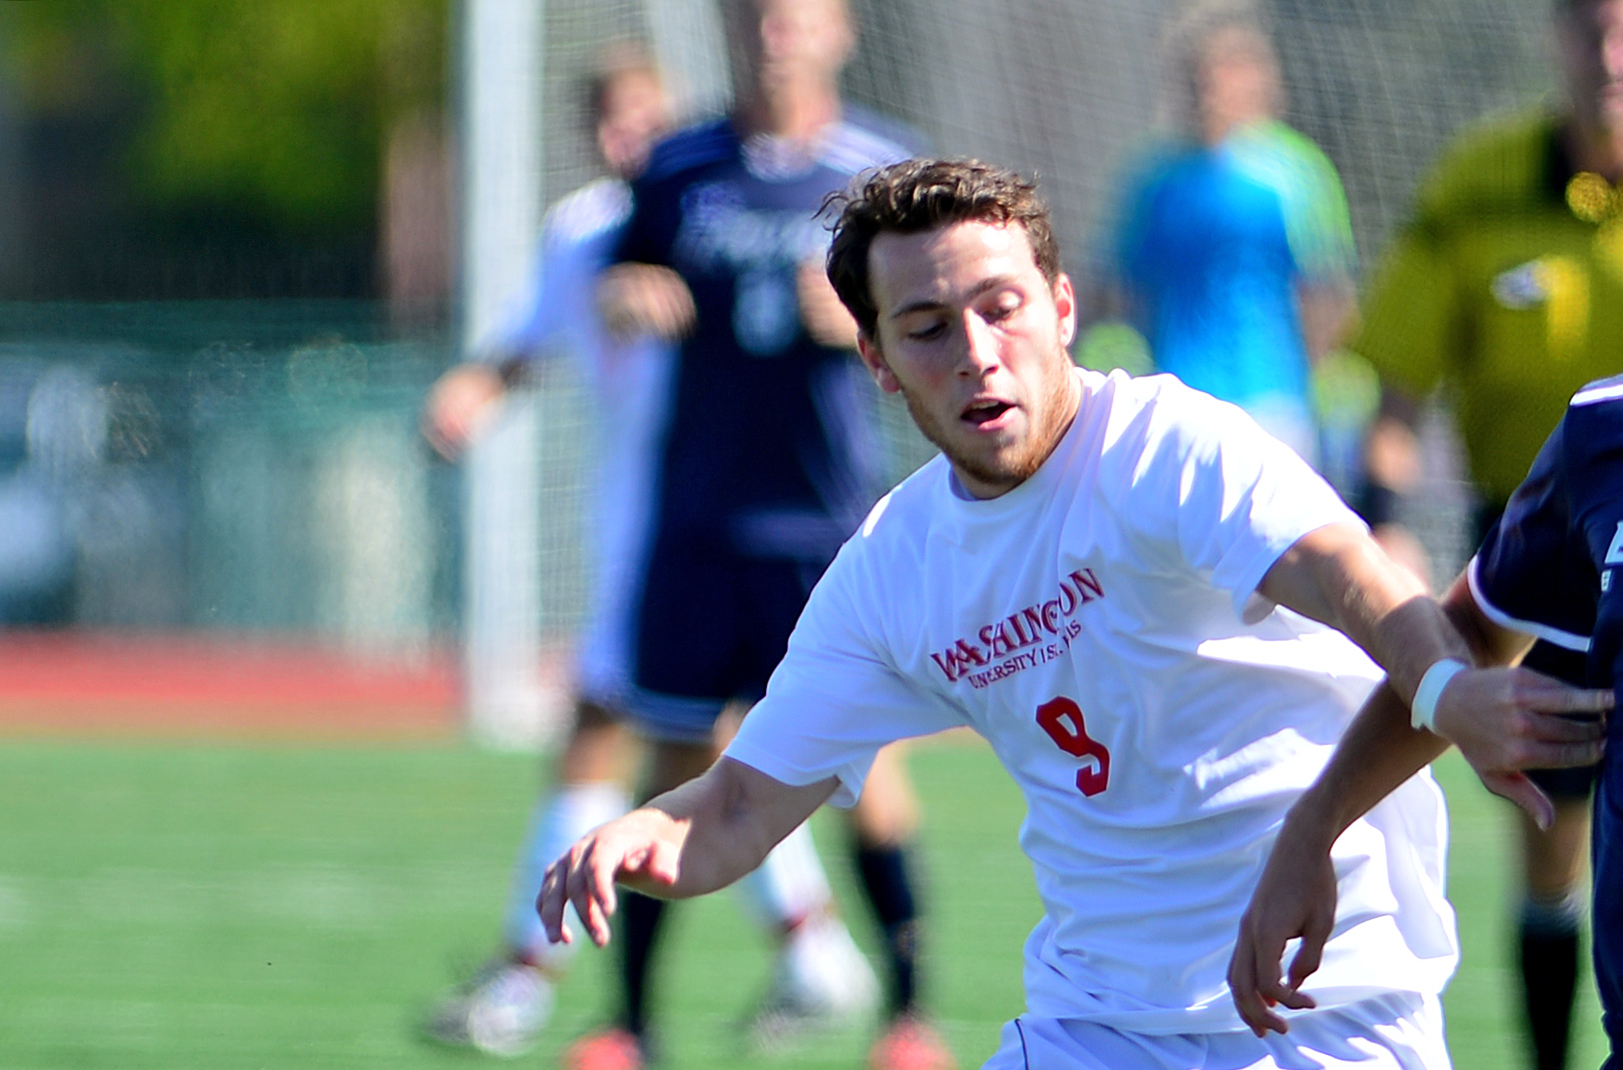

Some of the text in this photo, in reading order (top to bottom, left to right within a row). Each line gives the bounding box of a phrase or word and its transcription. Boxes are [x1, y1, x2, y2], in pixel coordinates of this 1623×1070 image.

[930, 567, 1105, 683] WASHINGON
[967, 646, 1038, 690] UNERSITY
[1035, 695, 1111, 798] 9
